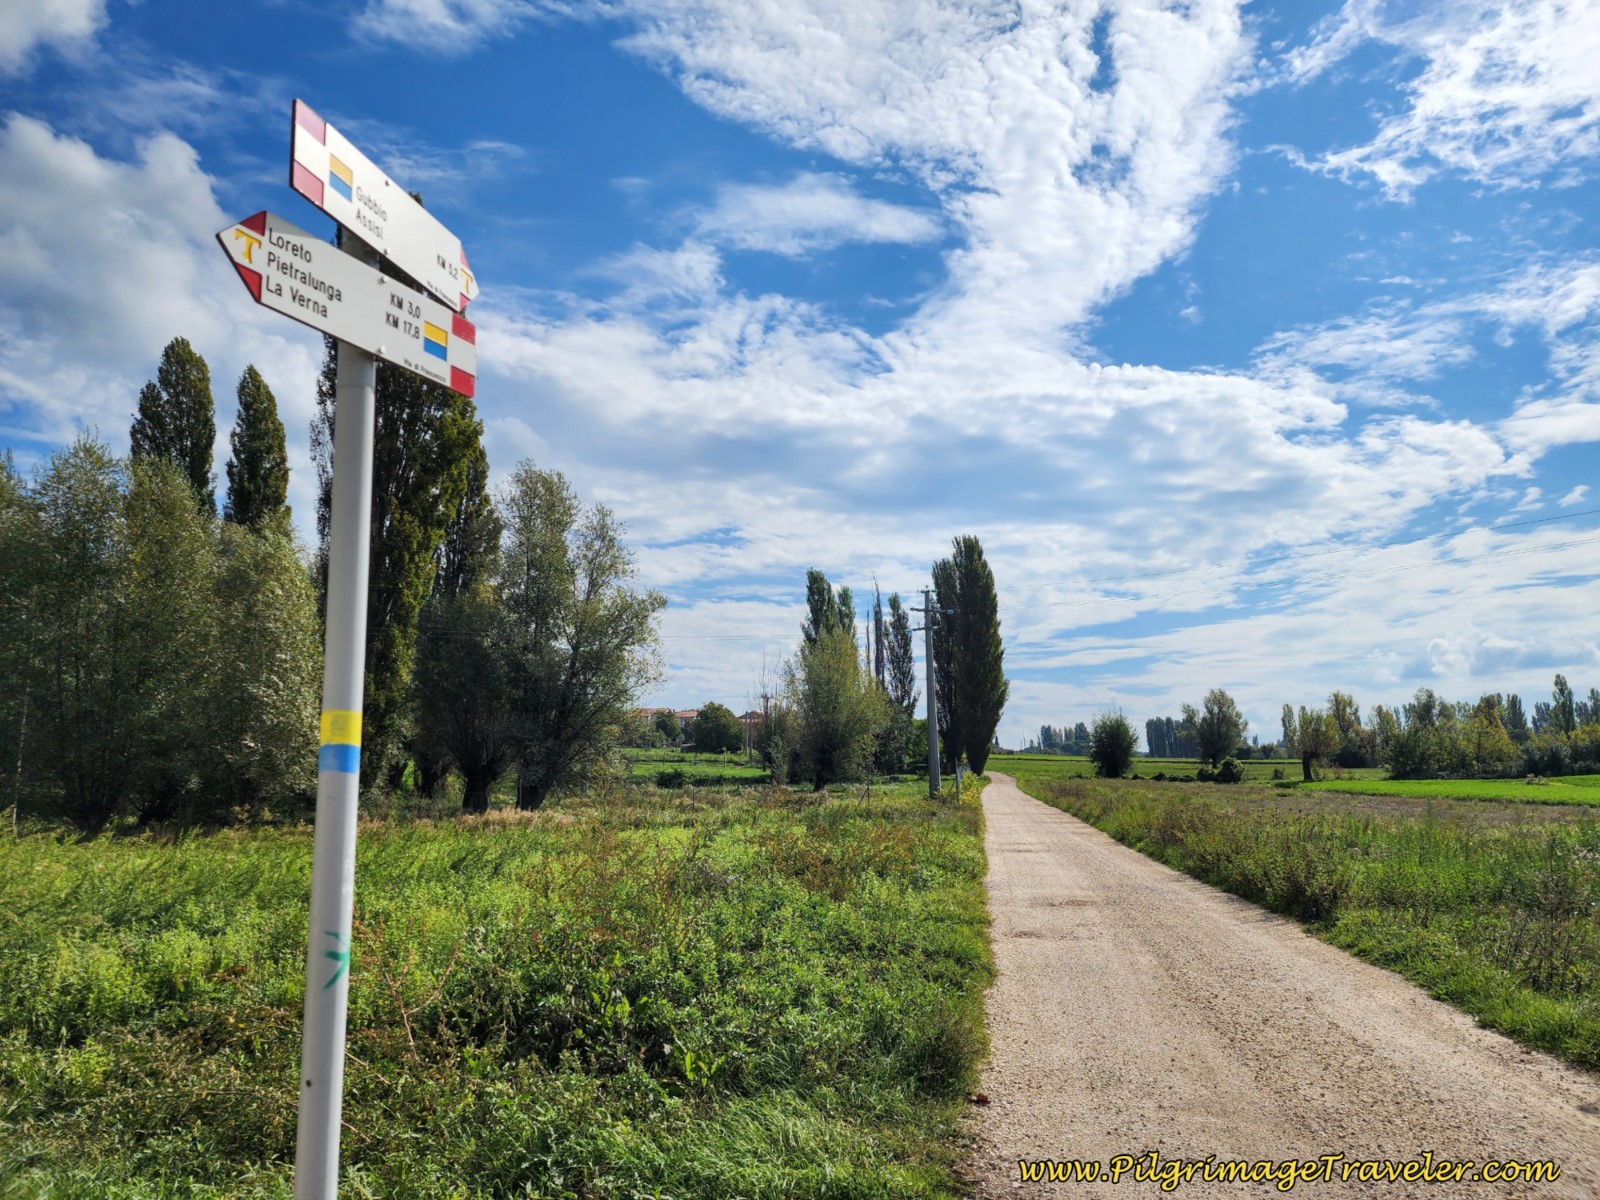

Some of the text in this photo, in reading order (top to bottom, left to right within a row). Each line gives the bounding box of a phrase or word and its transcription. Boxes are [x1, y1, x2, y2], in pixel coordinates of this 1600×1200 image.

[356, 186, 387, 221] Gubbio
[355, 208, 383, 239] Assisi
[269, 227, 312, 263] Loreto
[437, 253, 446, 270] KM
[267, 251, 342, 302] Pietralunga
[266, 275, 328, 318] La Verna
[390, 292, 403, 310] KM
[385, 311, 399, 329] KM
